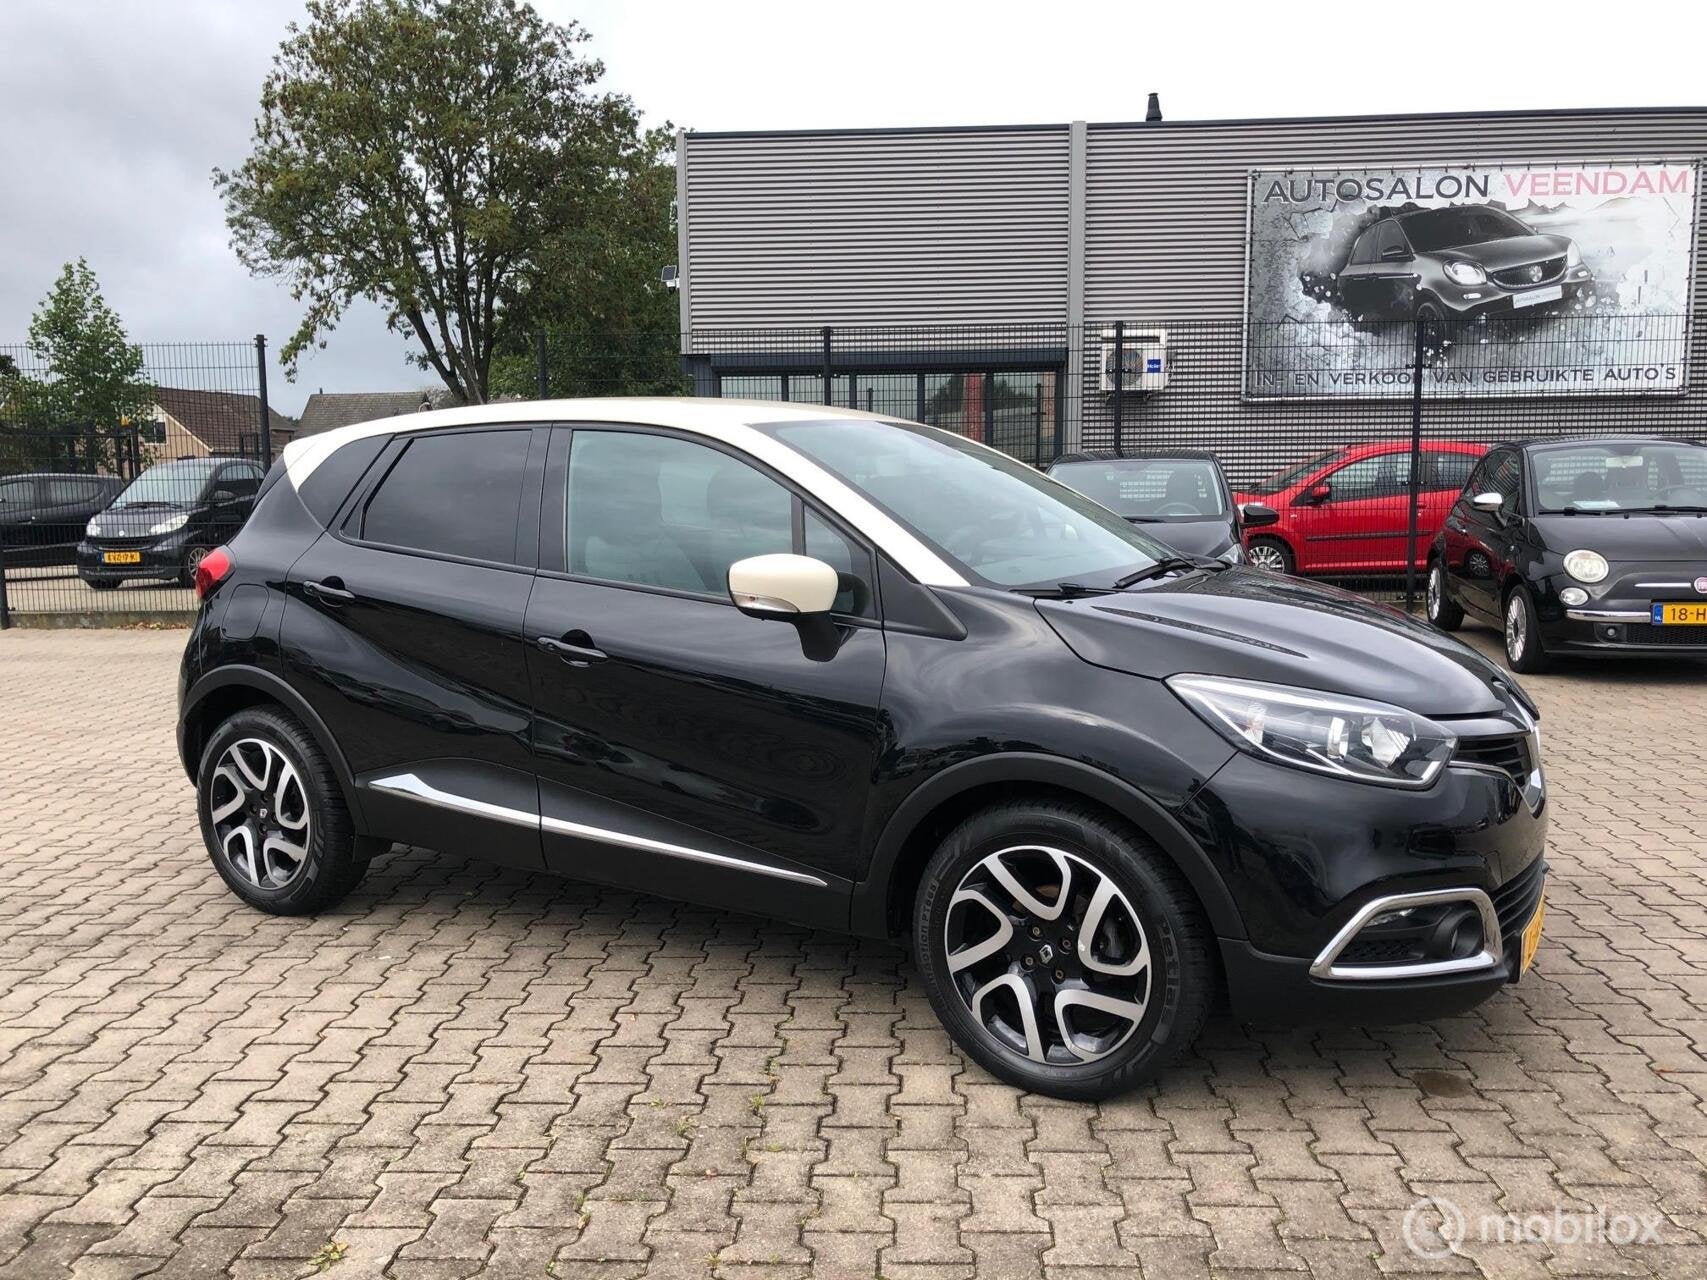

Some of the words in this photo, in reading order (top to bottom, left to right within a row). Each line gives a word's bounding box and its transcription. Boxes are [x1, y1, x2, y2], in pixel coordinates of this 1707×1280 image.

[1263, 174, 1489, 203] AUTOSALON
[1503, 170, 1688, 197] VEENDAM
[1295, 372, 1319, 386] EN
[1329, 371, 1420, 386] VERKOO
[1433, 371, 1473, 384] VAN
[1483, 368, 1594, 384] GEBRUIKTE
[1603, 364, 1676, 381] AUTO'S
[1671, 607, 1707, 621] 18-H
